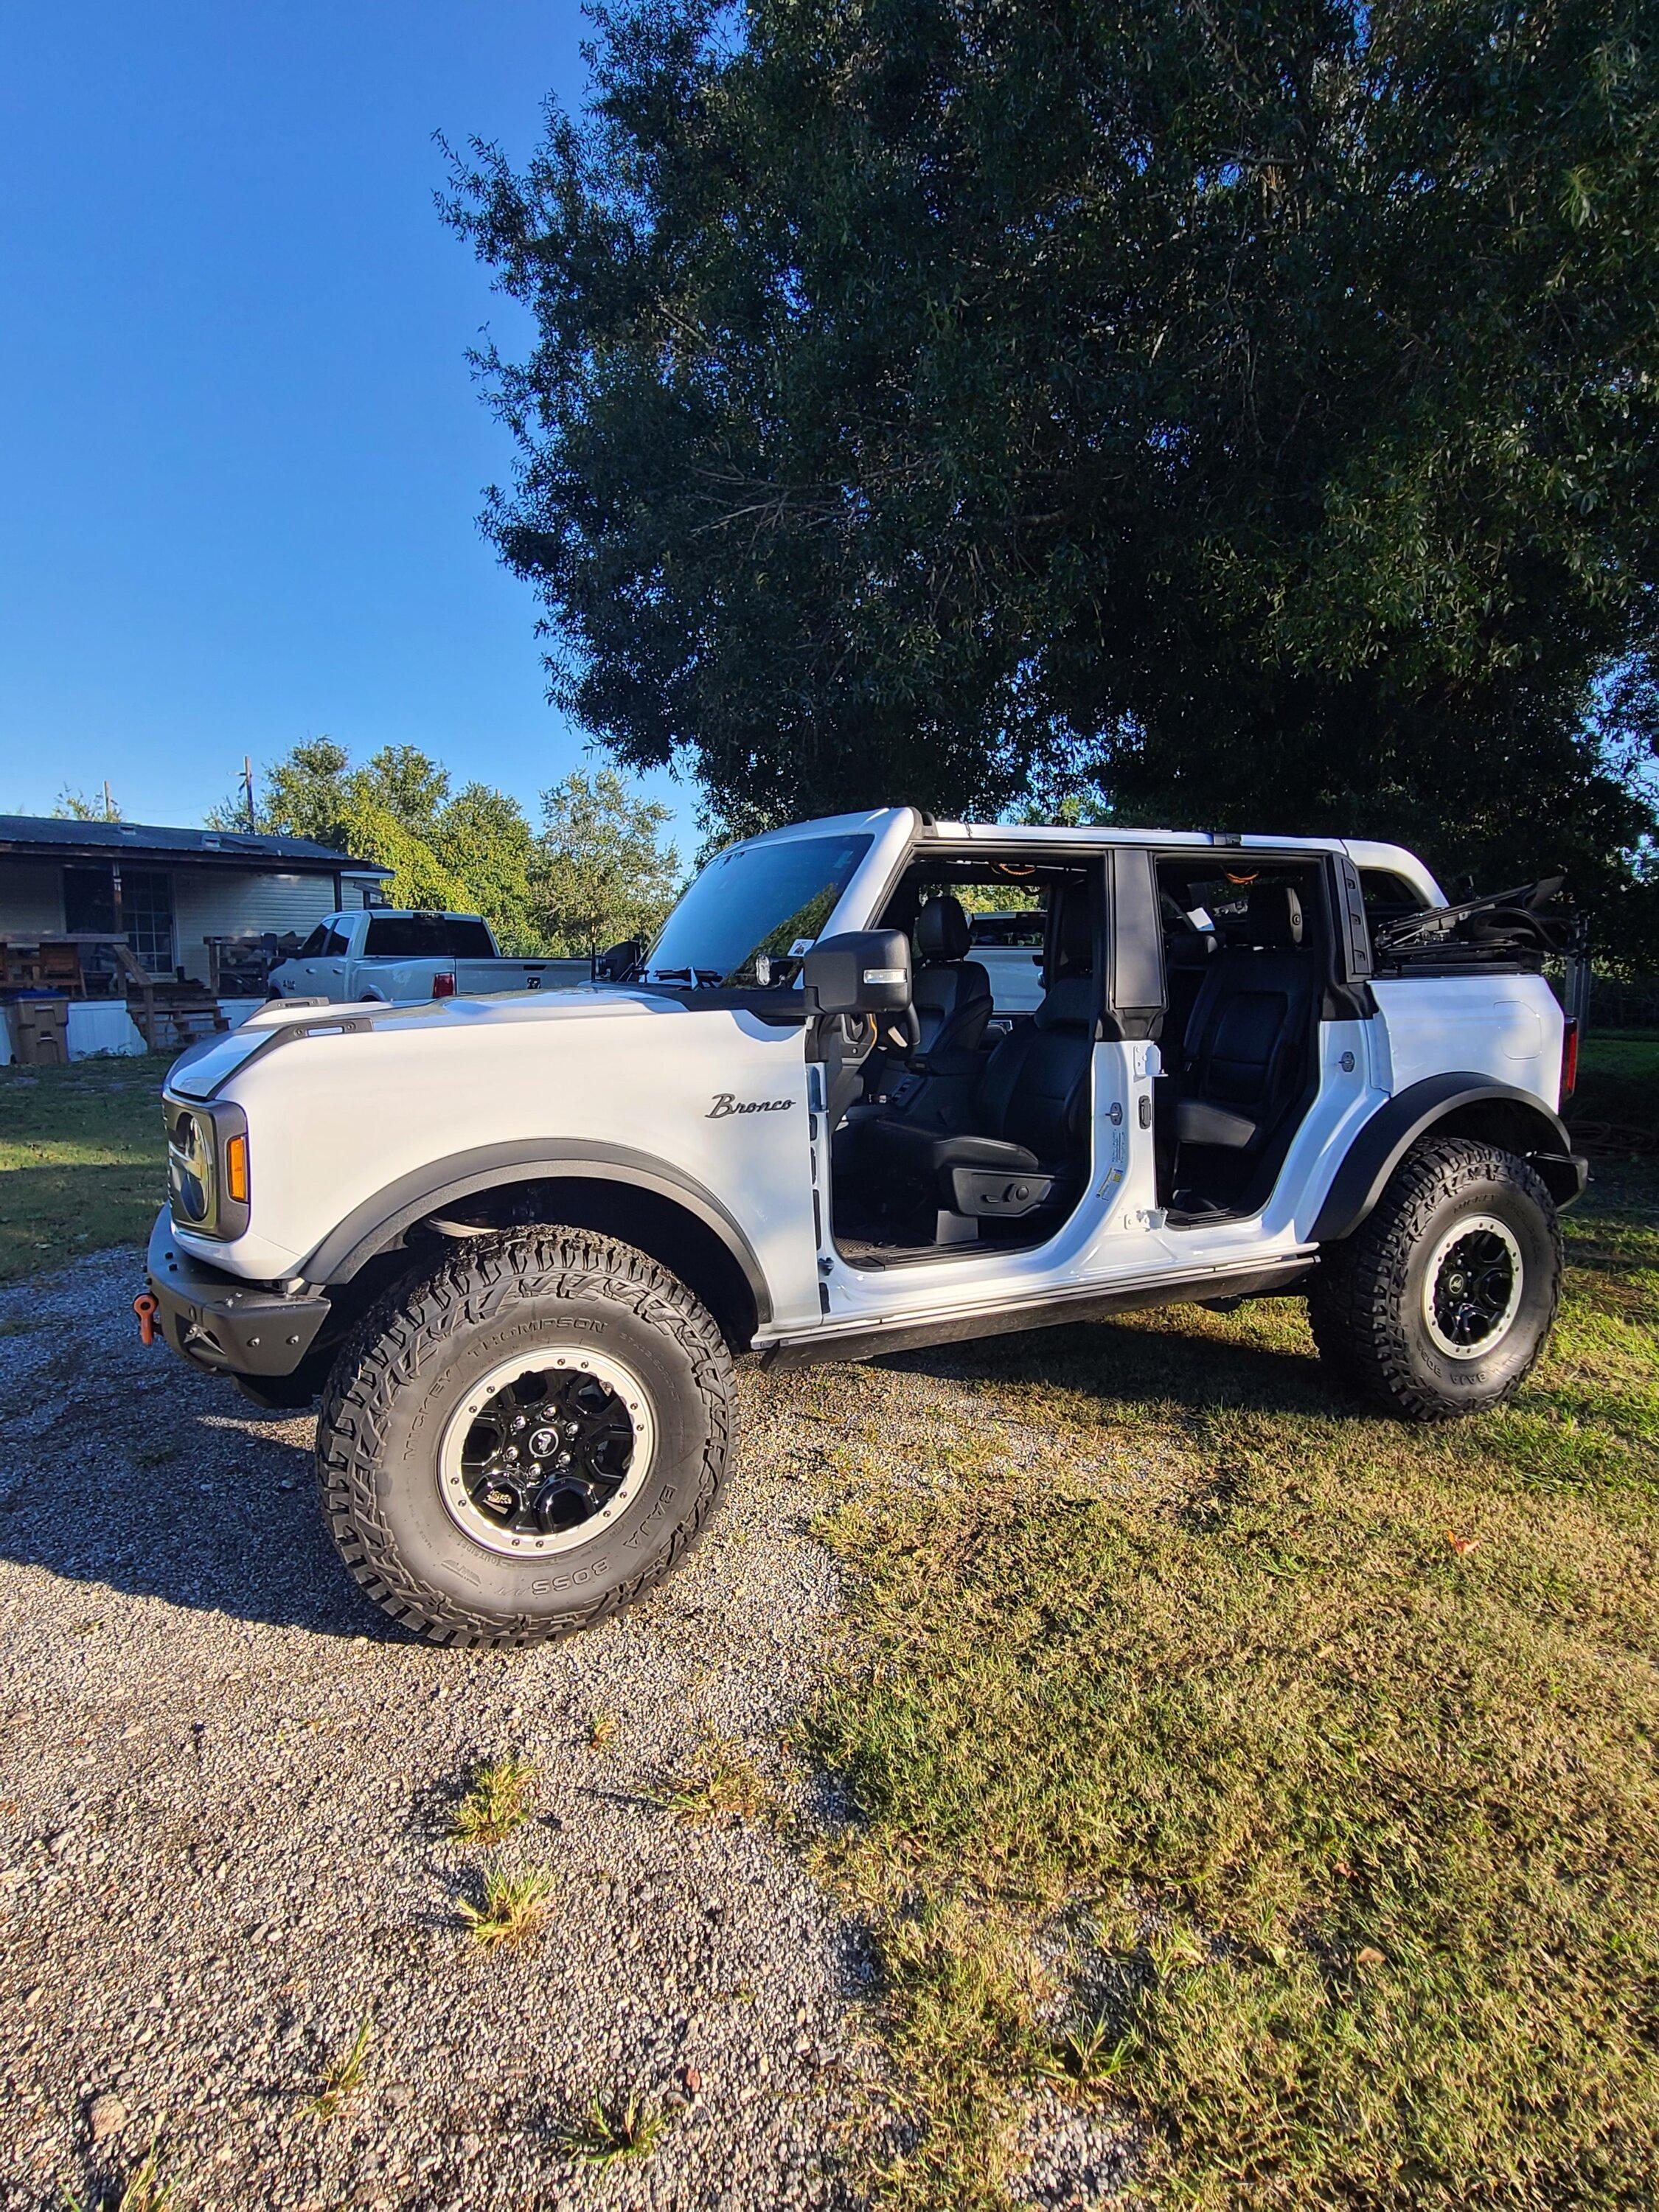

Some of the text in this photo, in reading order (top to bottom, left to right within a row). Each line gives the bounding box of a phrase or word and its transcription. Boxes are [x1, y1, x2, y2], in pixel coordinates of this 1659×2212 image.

[704, 1093, 796, 1119] Bronco
[403, 1316, 609, 1461] MICKEY THOMPSON
[623, 1484, 678, 1549] BAJA
[532, 1557, 611, 1596] BOSS
